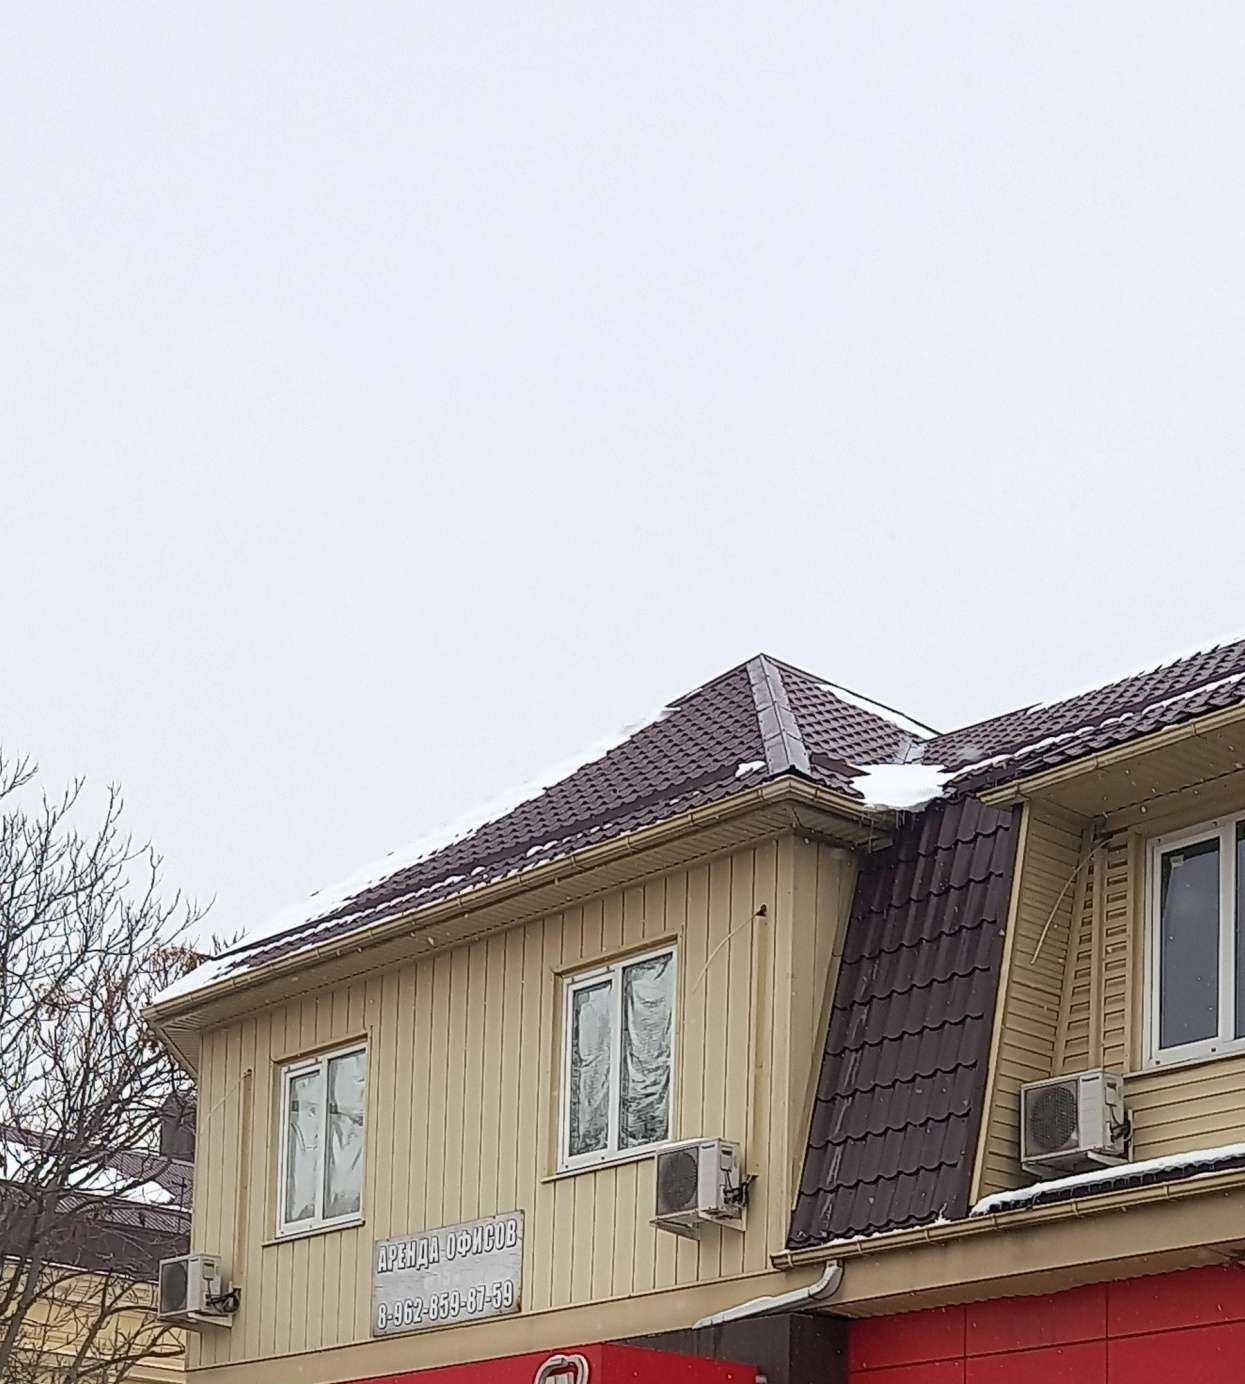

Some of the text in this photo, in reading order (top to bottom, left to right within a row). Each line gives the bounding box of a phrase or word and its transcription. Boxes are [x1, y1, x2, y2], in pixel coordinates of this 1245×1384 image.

[377, 1219, 518, 1273] АРЕНДА ОФИСОВ
[377, 1279, 514, 1330] 8-962-859-87-59
